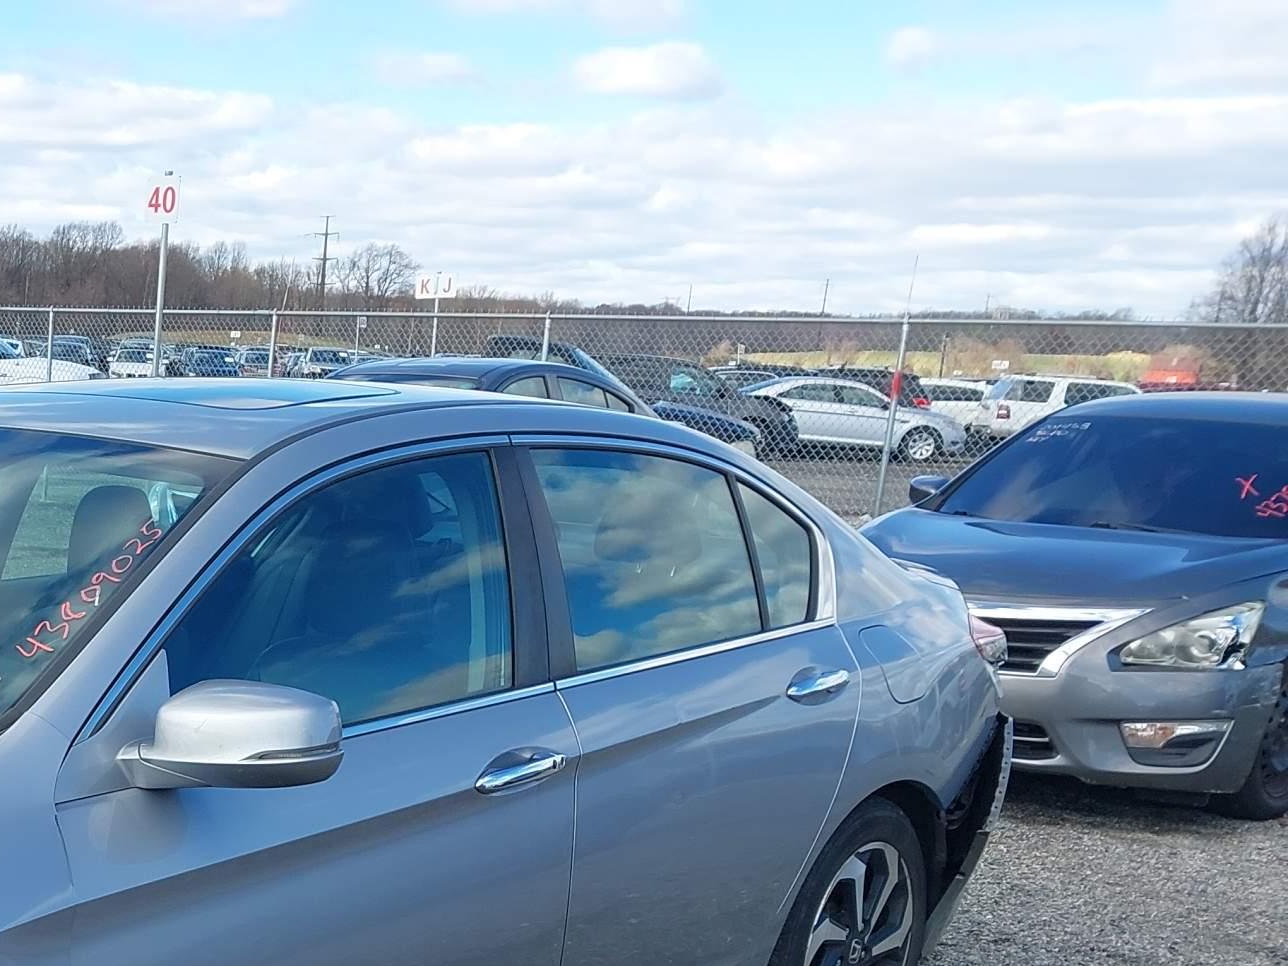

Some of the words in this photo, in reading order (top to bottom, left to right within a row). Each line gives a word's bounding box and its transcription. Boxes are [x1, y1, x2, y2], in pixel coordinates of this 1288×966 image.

[148, 186, 176, 214] 40
[420, 278, 431, 294] K
[442, 277, 452, 293] J
